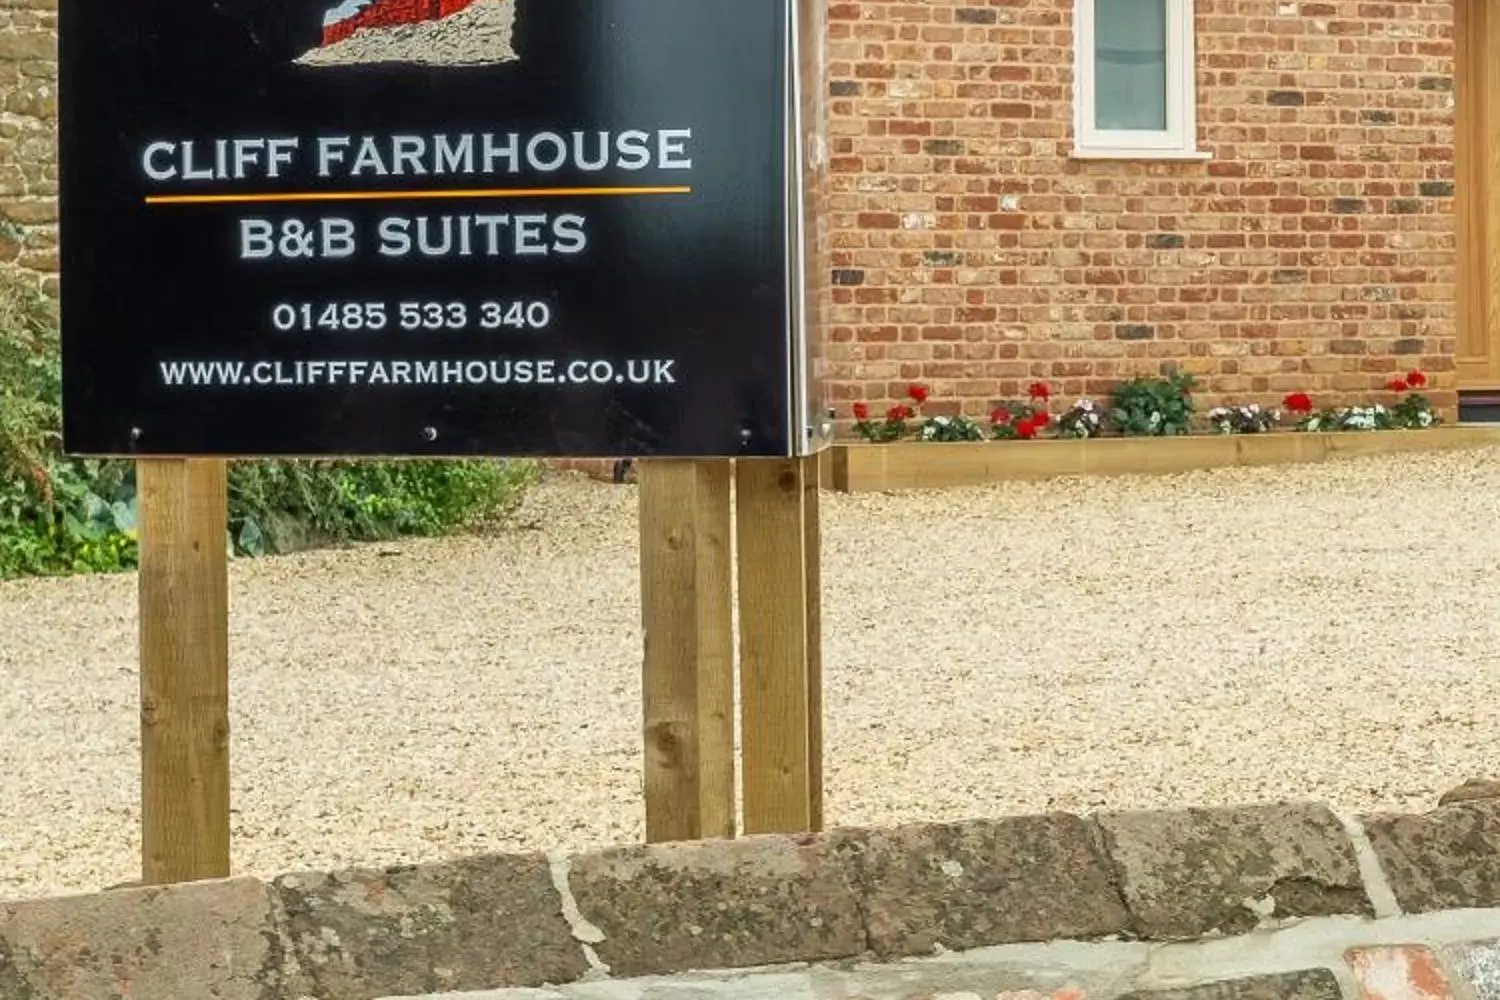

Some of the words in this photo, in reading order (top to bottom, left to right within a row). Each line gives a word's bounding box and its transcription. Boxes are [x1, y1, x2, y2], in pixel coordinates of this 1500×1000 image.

[144, 138, 298, 180] CLIFF
[318, 128, 692, 176] FARMHOUSE
[240, 219, 354, 258] B&B
[379, 214, 586, 255] SUITES
[273, 303, 387, 330] 01485
[399, 302, 467, 329] 533
[480, 302, 550, 329] 340
[160, 360, 676, 385] WWW.CLIFFFARMHOUSE.CO.UK
